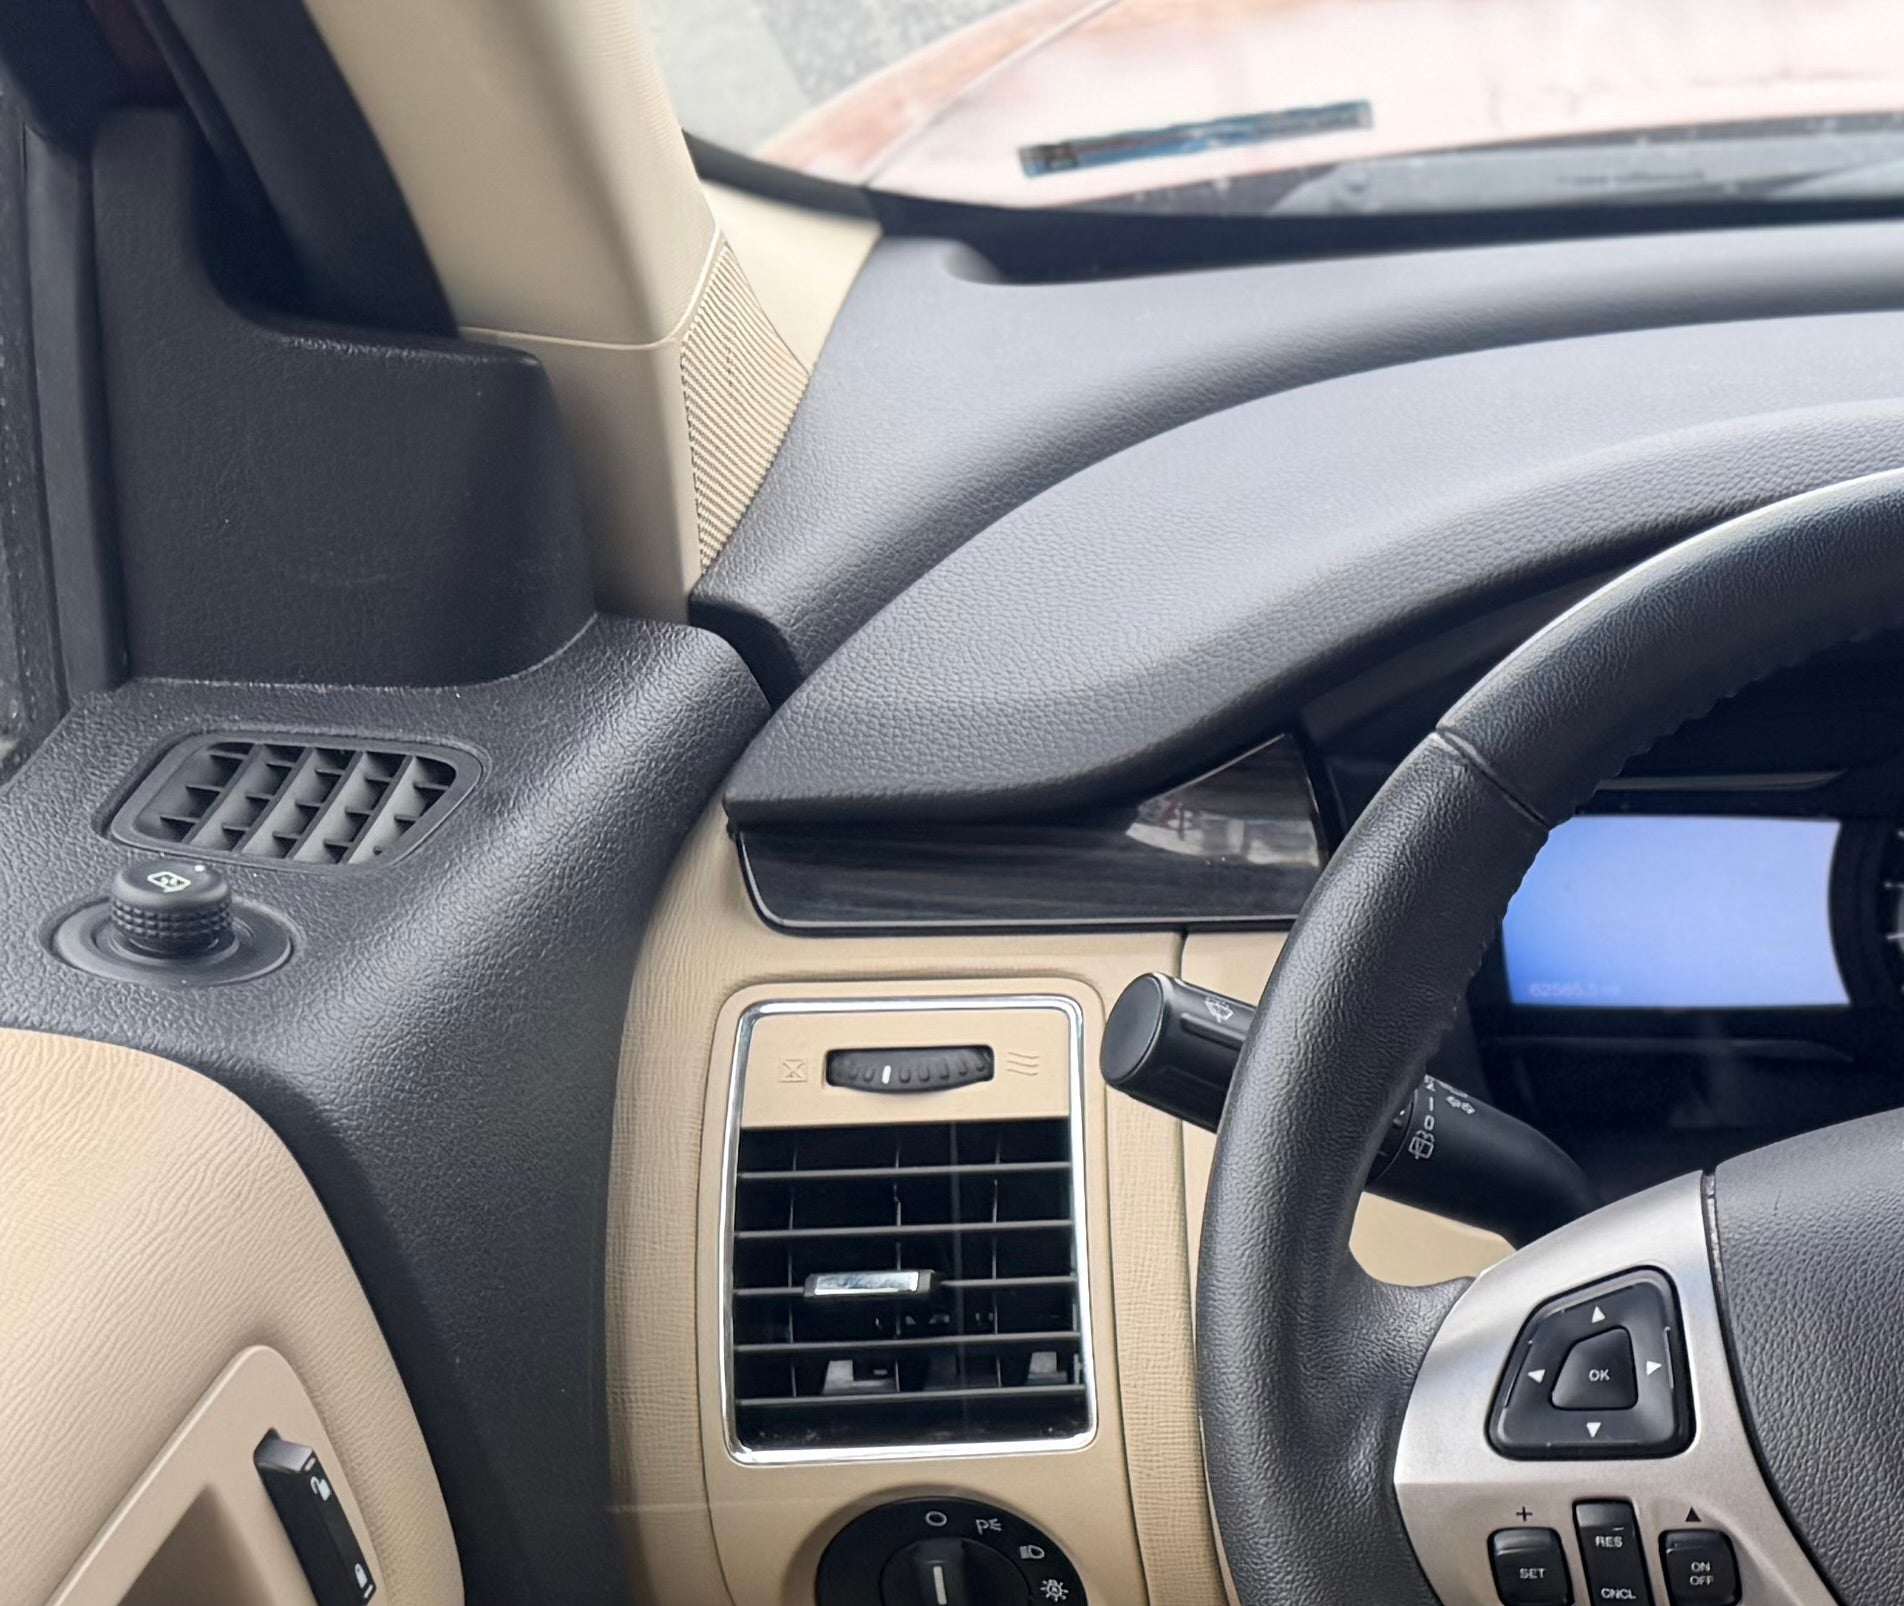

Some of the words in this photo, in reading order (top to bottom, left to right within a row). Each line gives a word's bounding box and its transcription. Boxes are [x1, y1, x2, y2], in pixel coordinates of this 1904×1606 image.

[1588, 1369, 1610, 1382] OK
[1595, 1536, 1623, 1548] RES
[1690, 1562, 1711, 1572] ON
[1519, 1568, 1546, 1579] SET
[1689, 1576, 1714, 1586] OFF
[1601, 1589, 1636, 1600] CNCL
